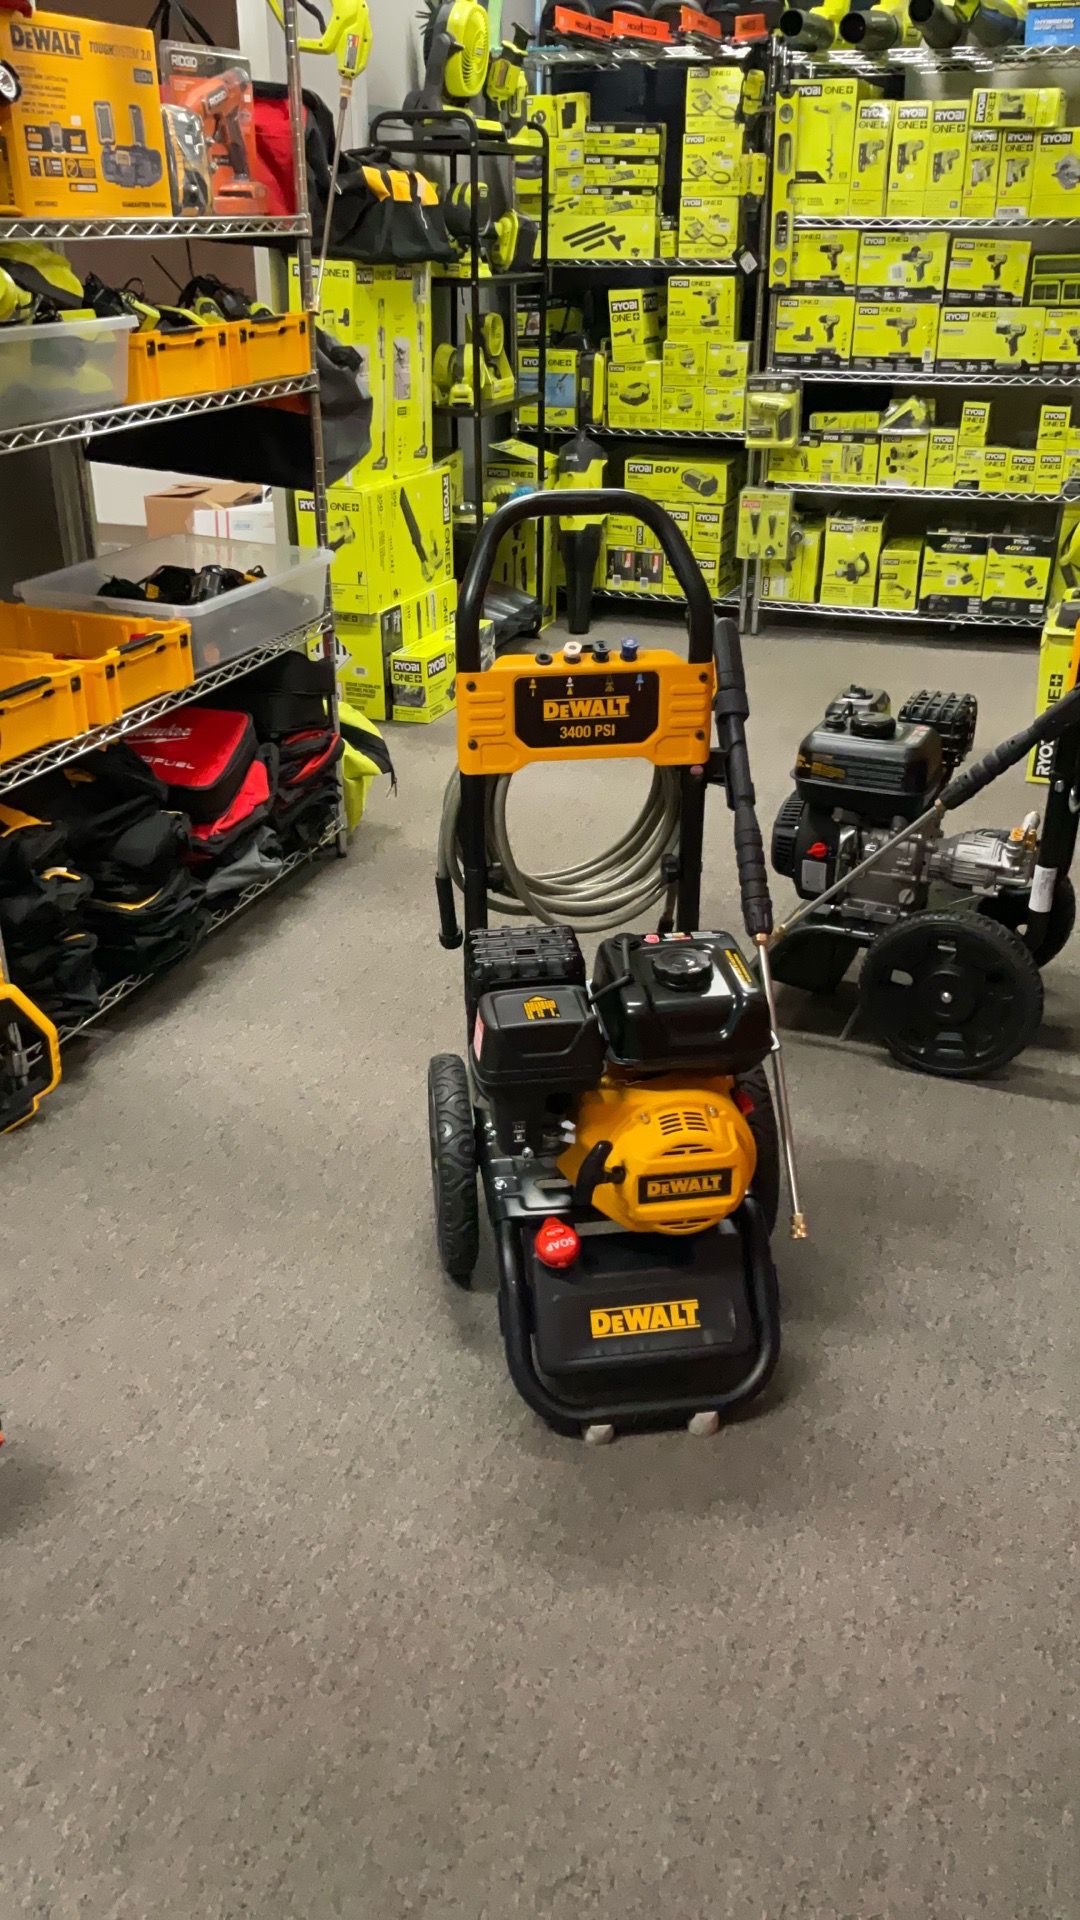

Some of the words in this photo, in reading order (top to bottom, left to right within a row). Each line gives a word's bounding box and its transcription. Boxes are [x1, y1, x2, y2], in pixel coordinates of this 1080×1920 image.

[10, 23, 81, 56] DEWALT
[171, 54, 197, 67] RIDGID
[691, 70, 709, 78] RYOBI
[825, 86, 853, 94] ONE+
[209, 90, 226, 105] RIDGID
[976, 93, 986, 121] RYOBI
[986, 92, 996, 122] ONE+
[861, 108, 887, 118] RYO
[900, 108, 927, 118] RYOBI
[935, 110, 965, 121] RYOBI
[897, 121, 927, 129] ONE+
[932, 123, 965, 133] ONE+
[972, 132, 997, 142] RYOBI
[1007, 133, 1033, 141] RYOBI
[1042, 134, 1071, 144] RYOBI
[970, 144, 998, 152] ONE+
[1005, 144, 1033, 152] ONE+
[865, 237, 885, 245] RYOBI
[323, 268, 349, 278] ONE+
[612, 301, 637, 312] RYOBI
[611, 313, 640, 323] ONE+
[945, 312, 969, 321] RYOBI
[972, 311, 996, 319] ONE+
[523, 357, 539, 367] RYO
[548, 359, 571, 367] ONE+
[965, 408, 985, 416] RYOBI
[1012, 456, 1034, 464] RYOBI
[629, 464, 652, 473] RYOBI
[655, 466, 679, 474] 80V
[299, 500, 316, 510] RYO
[330, 503, 359, 511] ONE+
[697, 513, 719, 521] RYOBI
[830, 523, 853, 532] RYOBI
[394, 661, 420, 671] RYOBI
[428, 656, 446, 675] RYOBI
[448, 651, 456, 664] ON
[394, 674, 422, 683] ONE+
[543, 697, 629, 720] DEWALT
[1036, 739, 1054, 776] RYO
[1046, 674, 1063, 709] NE+
[560, 726, 592, 738] 3400
[595, 724, 615, 737] PSI
[154, 757, 195, 769] FUEL
[647, 1175, 722, 1198] DEWALT
[546, 1236, 576, 1252] SOAP
[591, 1301, 699, 1336] DEWALT
